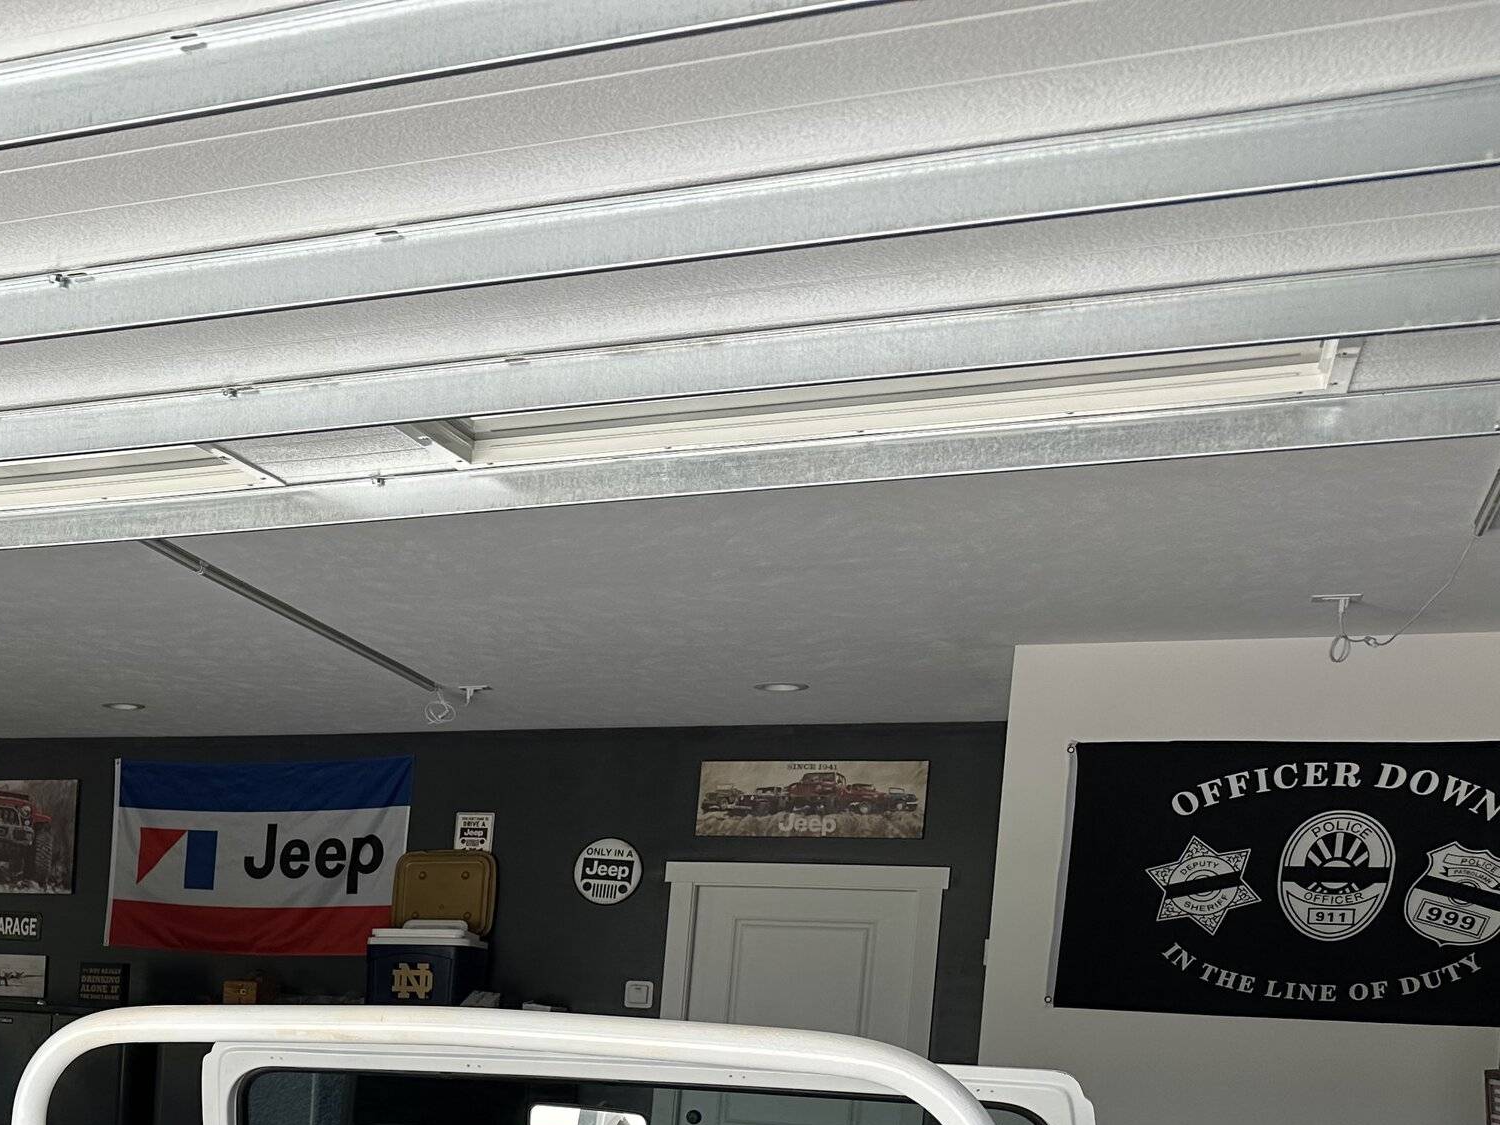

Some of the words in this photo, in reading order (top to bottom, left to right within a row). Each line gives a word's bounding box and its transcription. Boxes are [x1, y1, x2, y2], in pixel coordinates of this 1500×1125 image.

[1171, 762, 1362, 816] OFFICER
[1375, 763, 1500, 822] DOWN
[778, 813, 837, 836] Jeep
[1311, 821, 1373, 839] POLICE
[244, 824, 384, 894] Jeep
[586, 847, 612, 856] ONLY
[614, 849, 624, 857] IN
[626, 850, 633, 858] A
[585, 860, 630, 880] Jeep
[1180, 860, 1219, 875] DEPUTY
[1461, 858, 1500, 874] POLICE
[1184, 895, 1228, 912] SHERIFF
[1304, 892, 1364, 905] OFFICER
[1315, 912, 1346, 922] 911
[1426, 907, 1476, 930] 999
[1160, 942, 1198, 972] IN
[1199, 962, 1257, 994] THE
[1266, 980, 1338, 1002] LINE
[1348, 981, 1388, 1000] OF
[1397, 952, 1483, 996] DUTY
